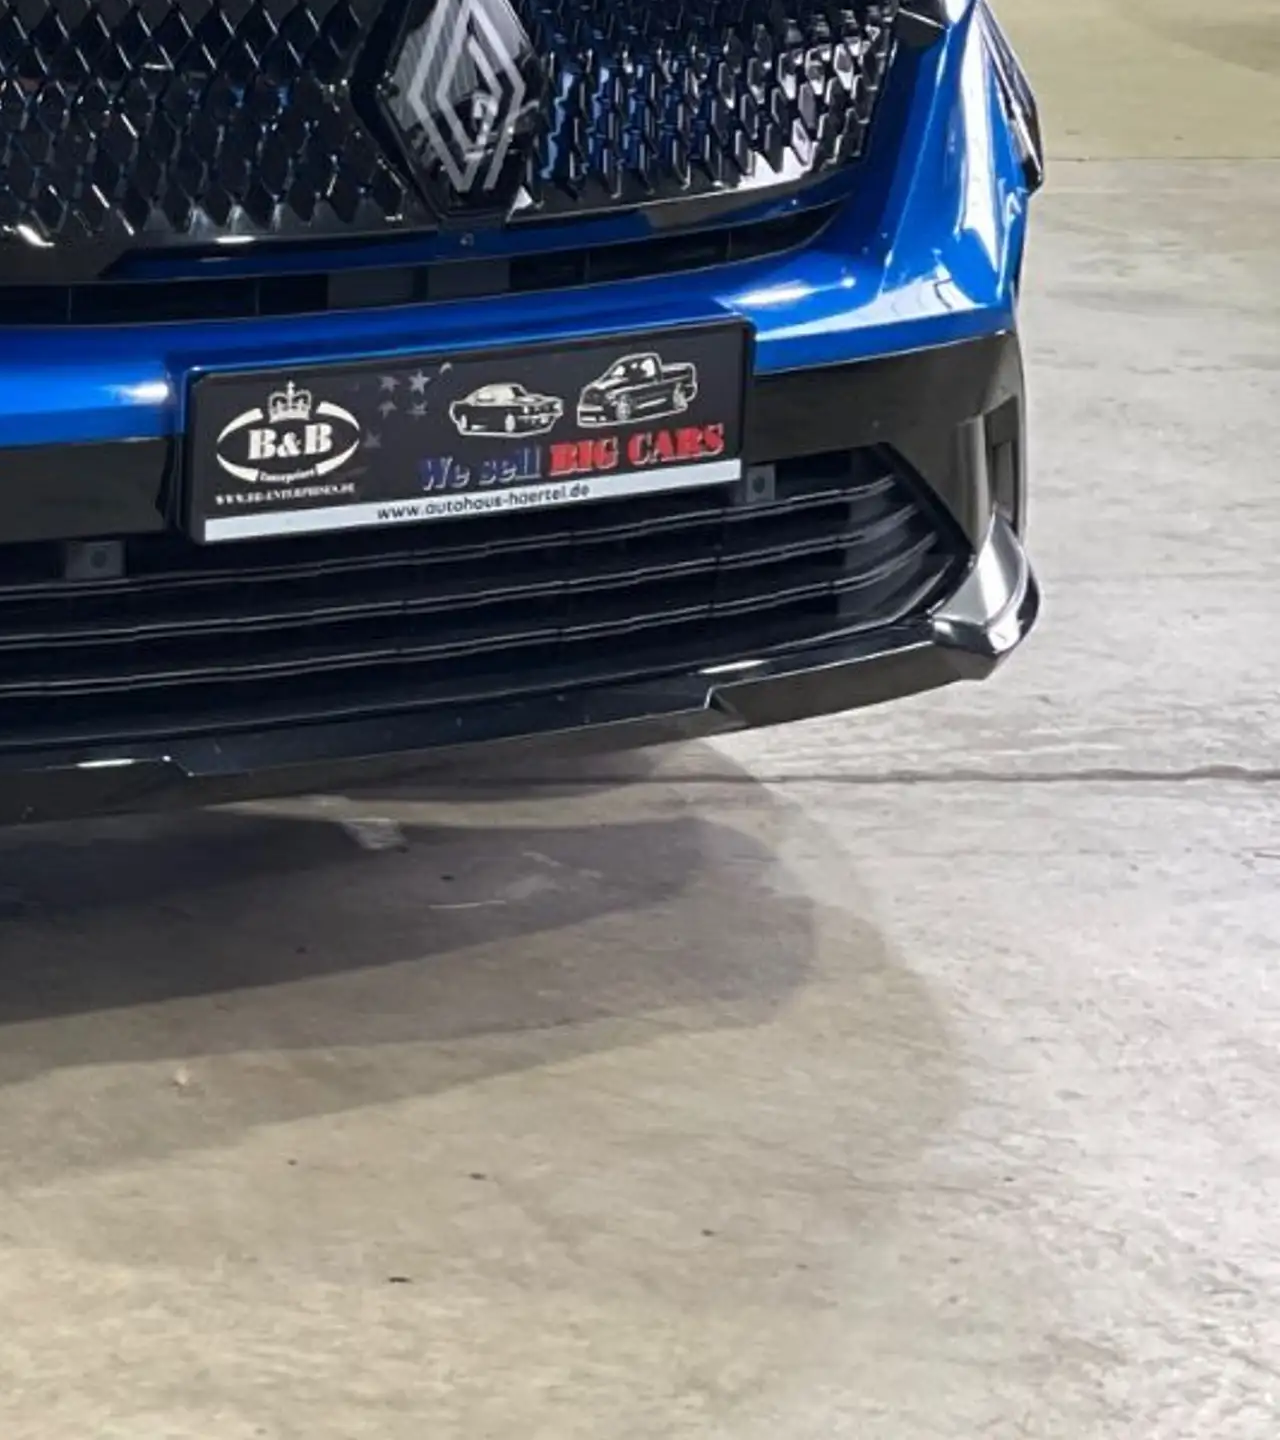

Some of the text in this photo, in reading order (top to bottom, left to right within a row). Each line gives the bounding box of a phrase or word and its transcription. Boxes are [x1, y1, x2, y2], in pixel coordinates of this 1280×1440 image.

[248, 423, 333, 460] B&B
[418, 423, 725, 492] We sell BIG CARS
[377, 483, 591, 520] www.autohaus-haertel.de
